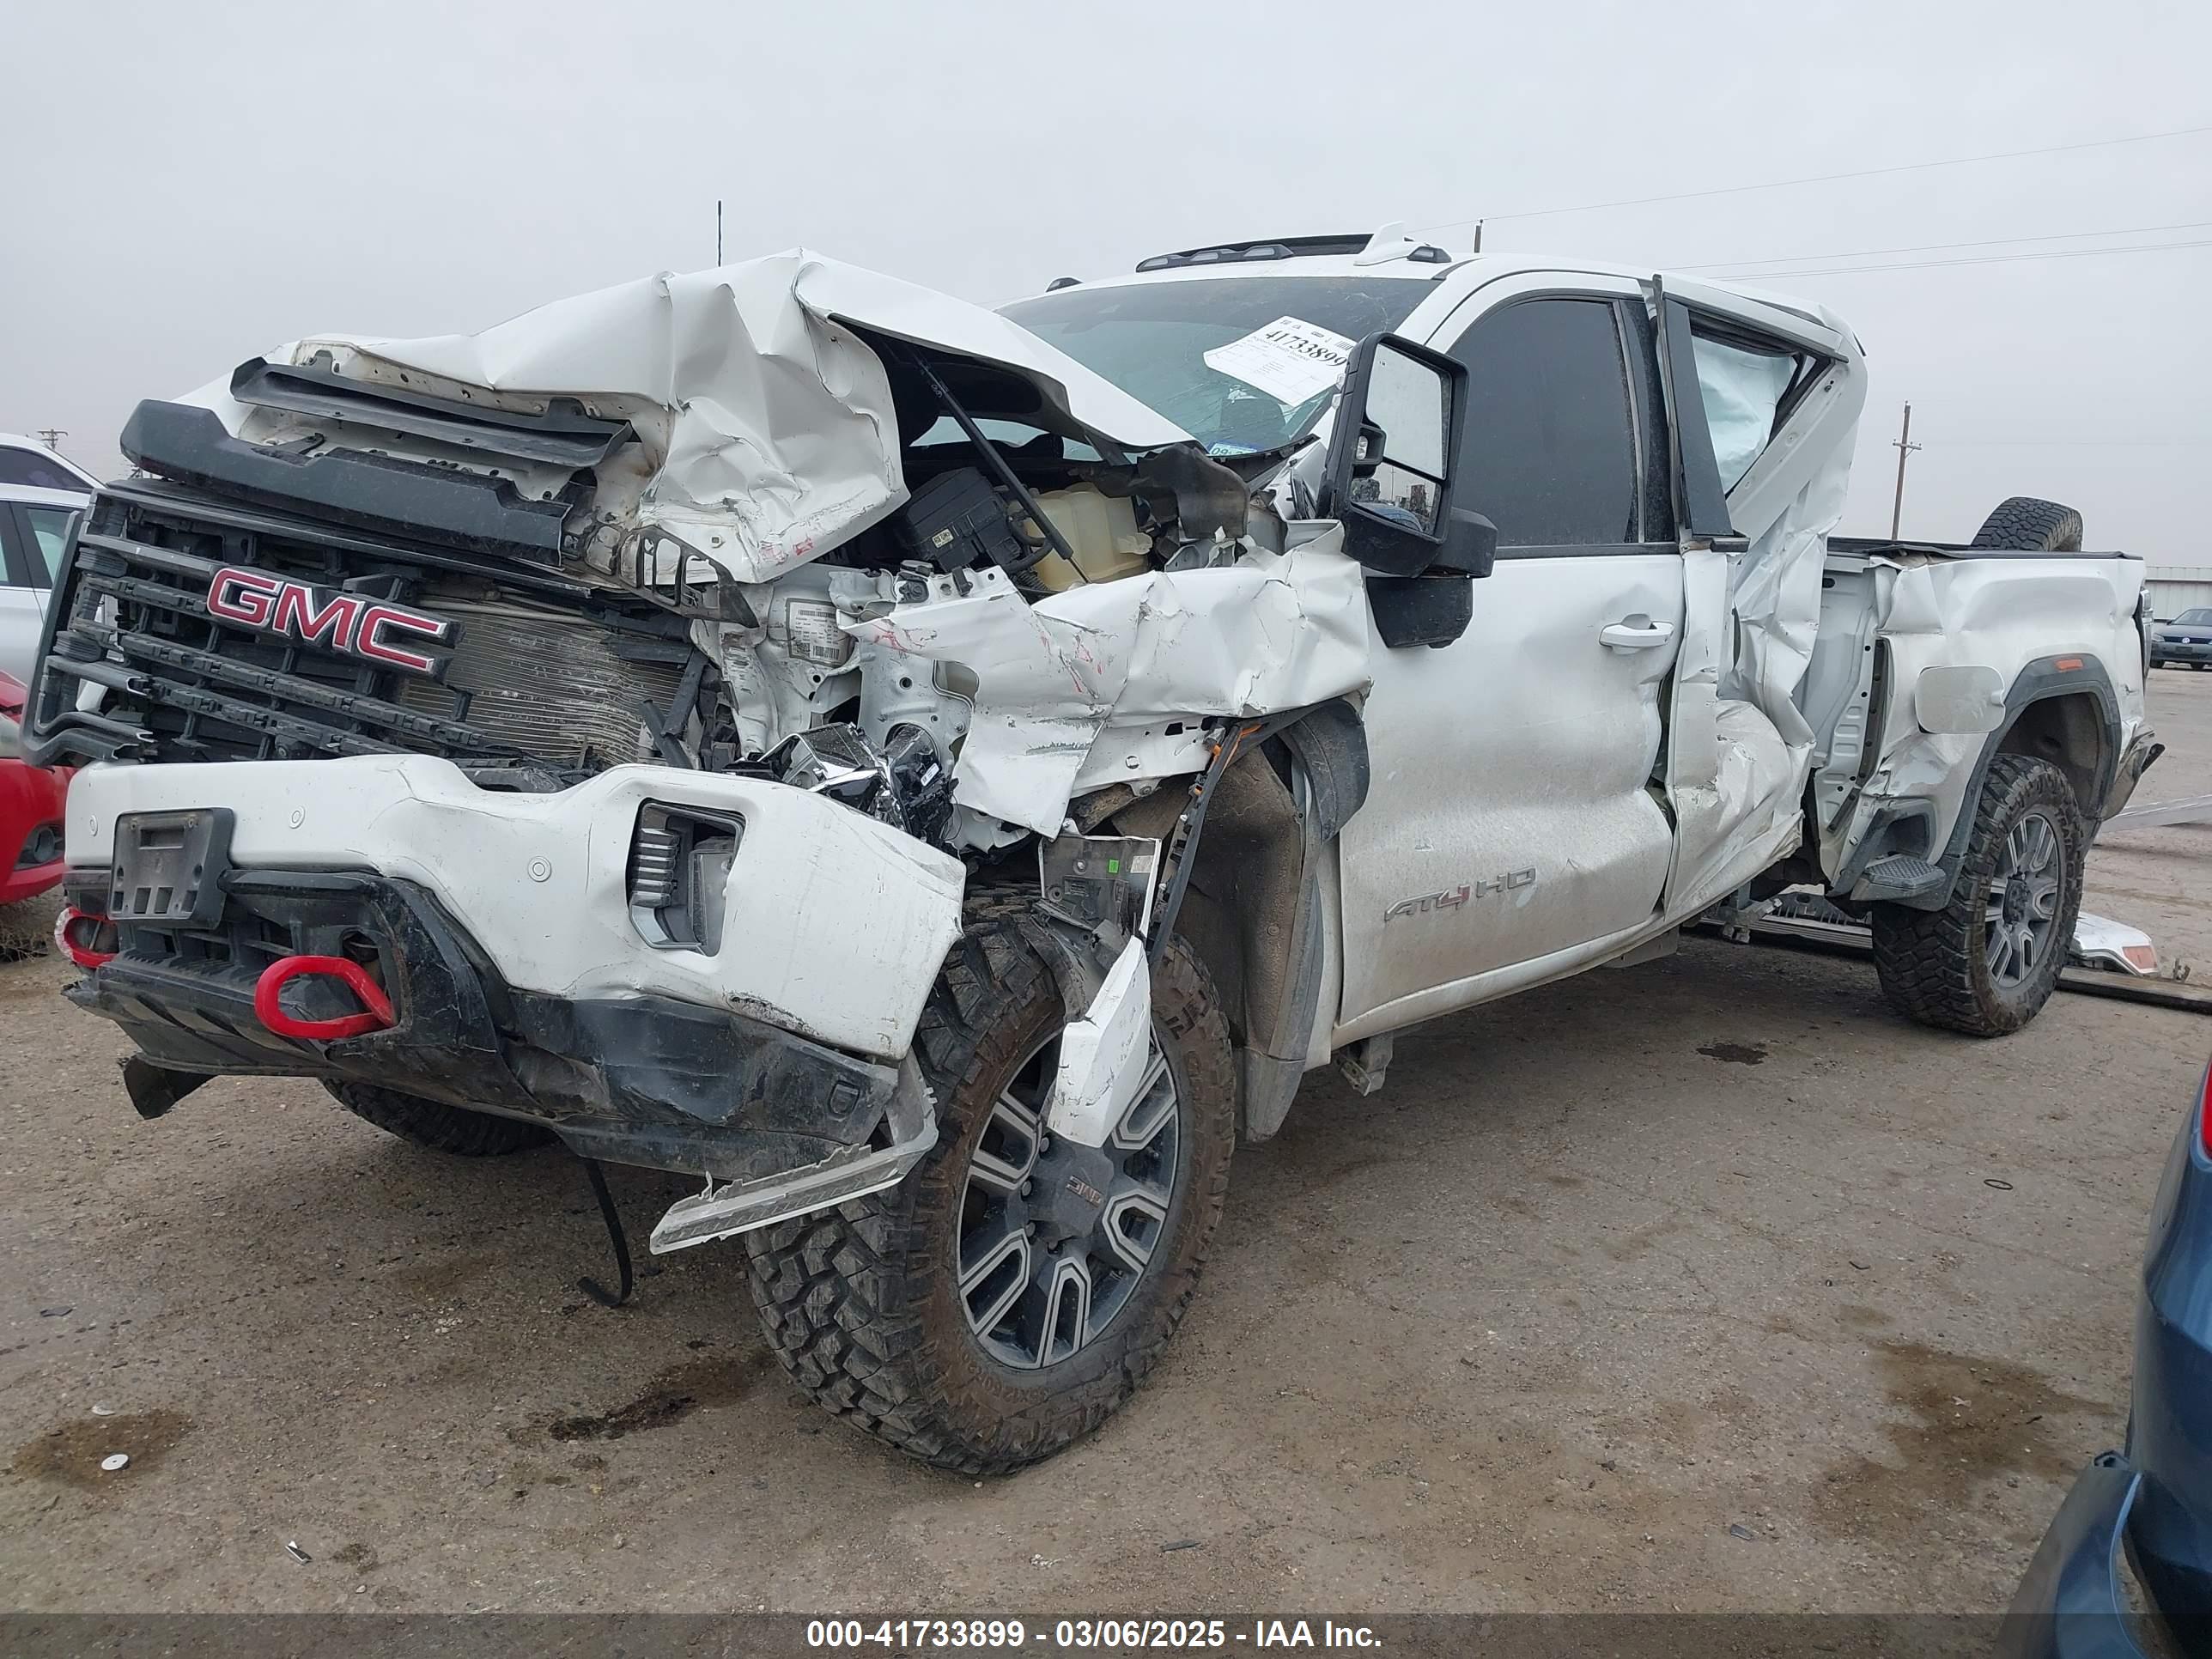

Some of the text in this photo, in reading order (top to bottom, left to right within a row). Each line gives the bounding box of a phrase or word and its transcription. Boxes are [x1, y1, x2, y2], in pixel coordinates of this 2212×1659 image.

[1265, 330, 1347, 367] 41733899
[206, 568, 447, 672] GMC
[1383, 866, 1537, 921] AT4 HD
